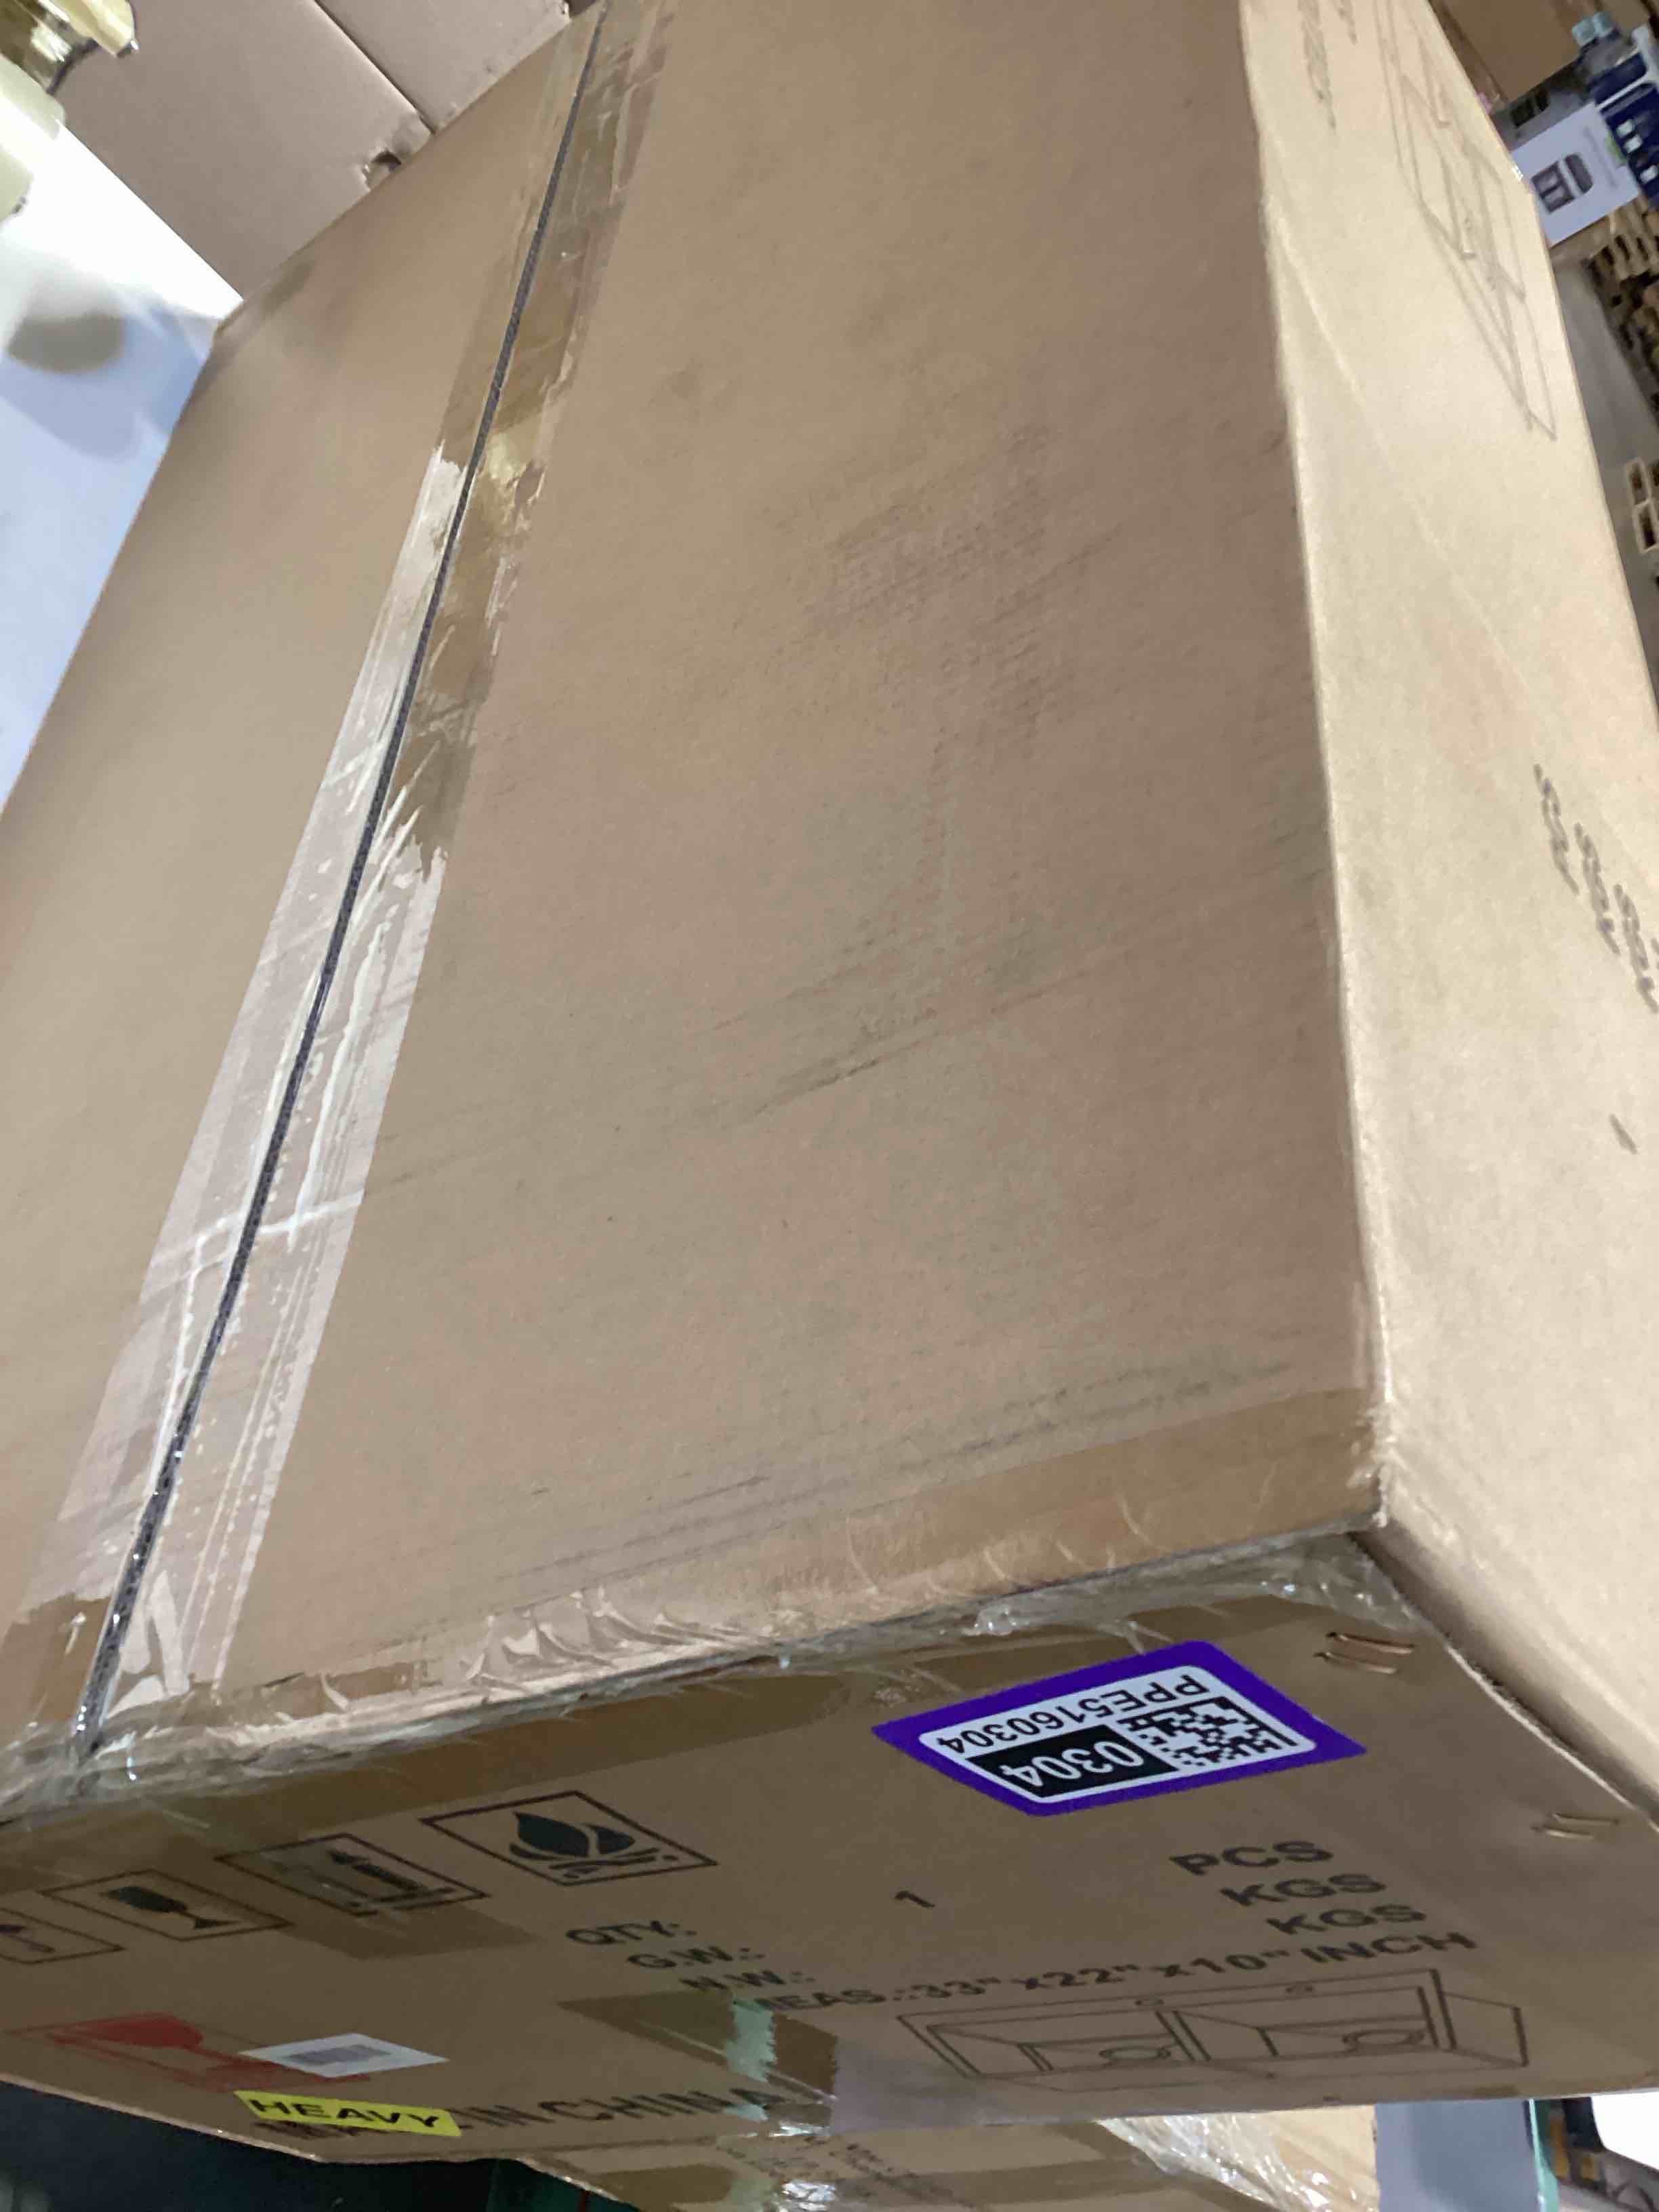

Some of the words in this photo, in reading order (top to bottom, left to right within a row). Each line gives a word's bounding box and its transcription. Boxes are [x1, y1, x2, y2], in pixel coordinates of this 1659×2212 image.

[937, 1674, 1210, 1755] PPE5160304
[999, 1740, 1145, 1788] 0304
[565, 1919, 697, 1946] QTY:
[894, 1890, 936, 1908] 1
[1168, 1841, 1334, 1875] PCS
[1218, 1873, 1388, 1906] KGS
[1265, 1904, 1427, 1935] KGS
[1299, 1931, 1477, 1963] INCH
[249, 2098, 440, 2128] HEAVY
[537, 2087, 790, 2121] CHINA
